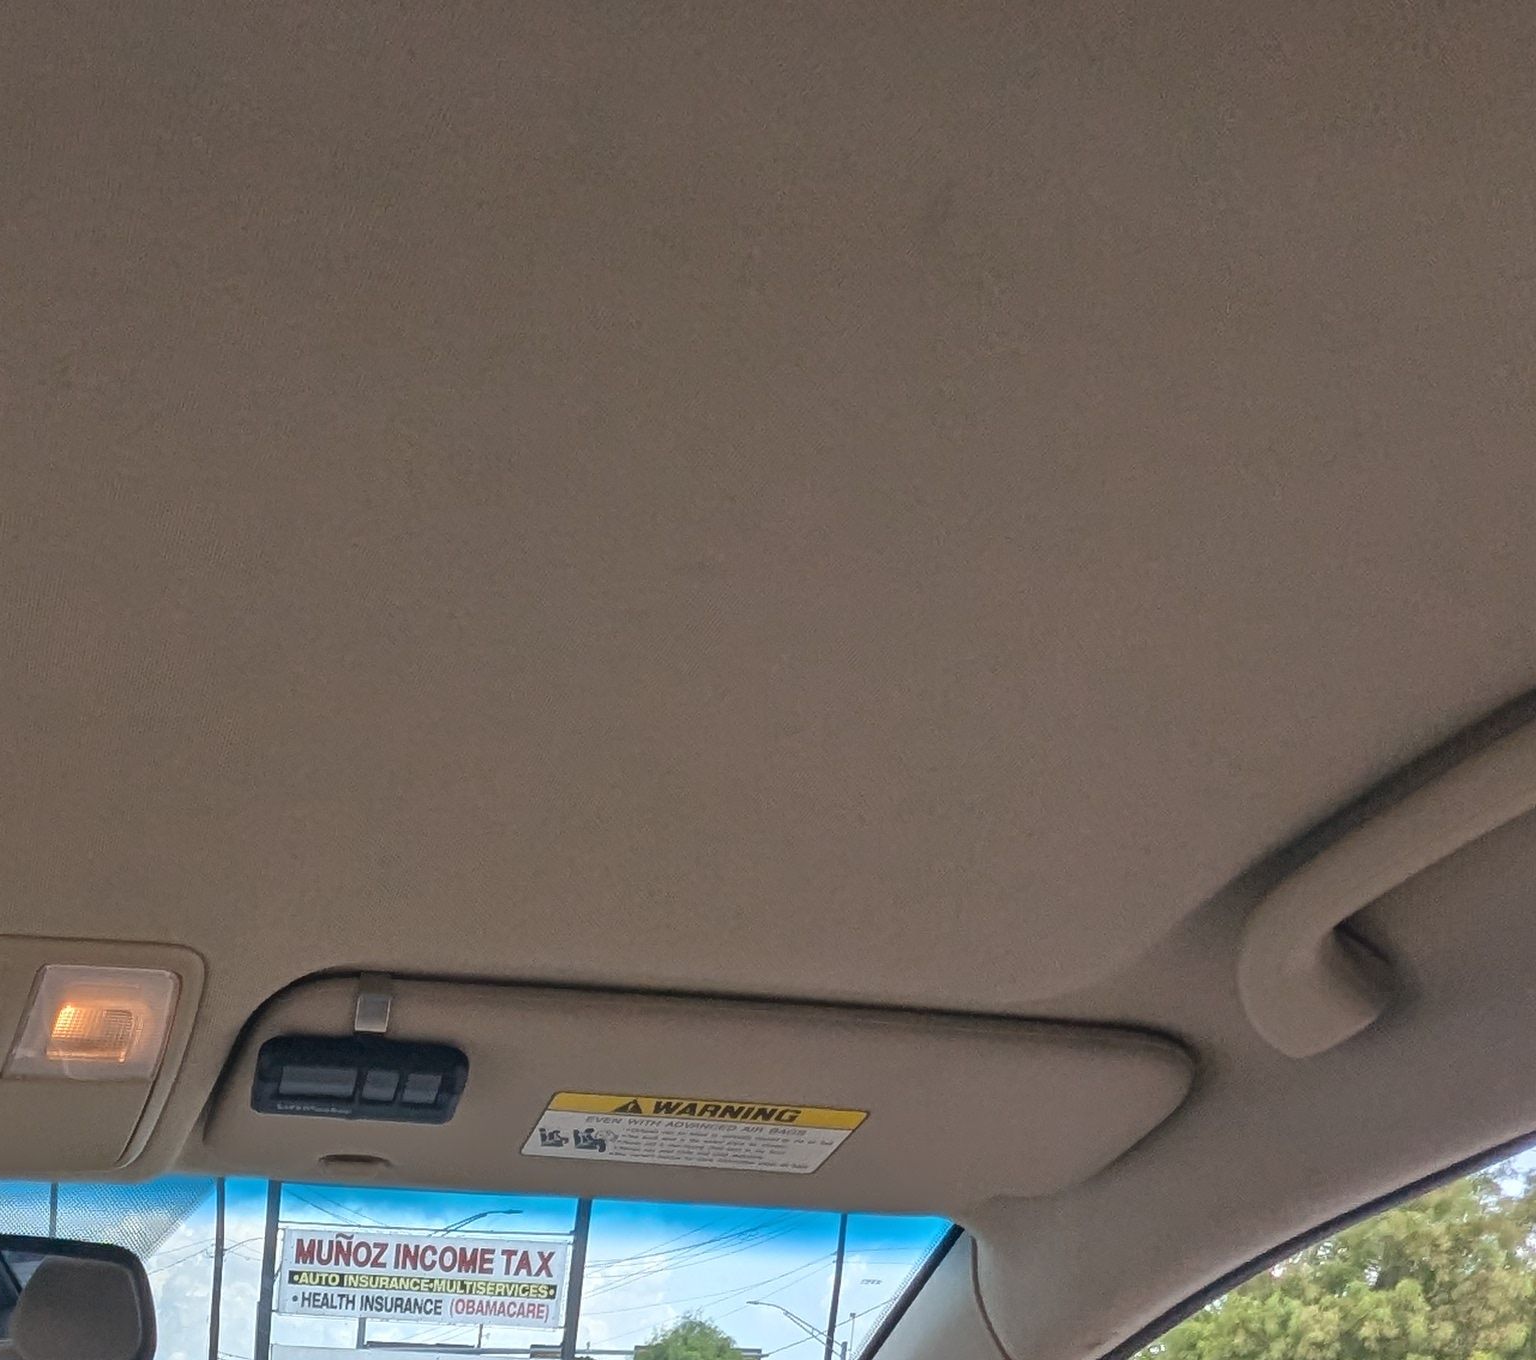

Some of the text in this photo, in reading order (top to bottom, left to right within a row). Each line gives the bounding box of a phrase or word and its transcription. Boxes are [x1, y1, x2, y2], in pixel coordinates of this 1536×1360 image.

[585, 1116, 625, 1125] EVEN
[628, 1119, 662, 1128] WITH
[665, 1121, 737, 1132] ADVANCED
[740, 1126, 764, 1134] AIR
[653, 1100, 802, 1123] WARNING
[294, 1232, 556, 1278] MUÑOZ INCOME TAX
[301, 1291, 550, 1323] HEALTH INSURANCE (OBAMACARE)
